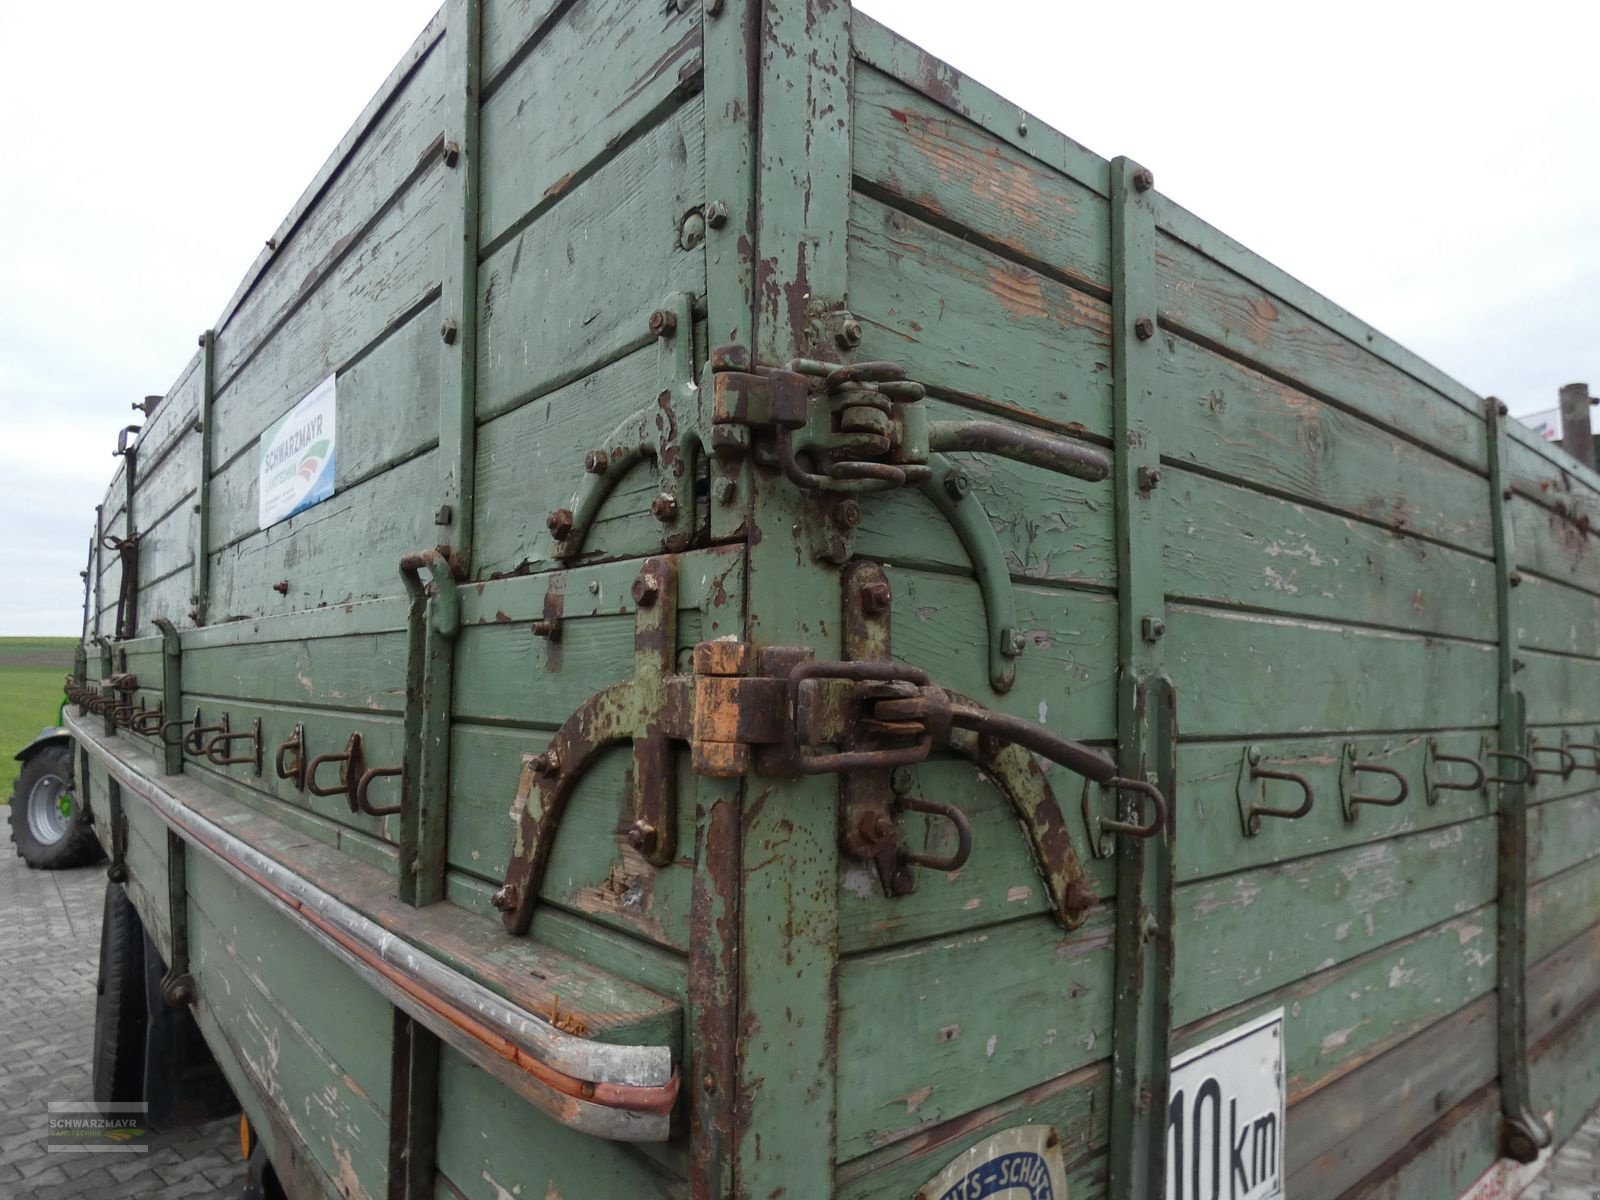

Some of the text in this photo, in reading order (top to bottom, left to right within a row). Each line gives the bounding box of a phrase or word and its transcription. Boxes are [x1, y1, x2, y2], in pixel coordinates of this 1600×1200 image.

[264, 414, 323, 474] SCHWARZMAYR
[1168, 1077, 1276, 1200] 10 km
